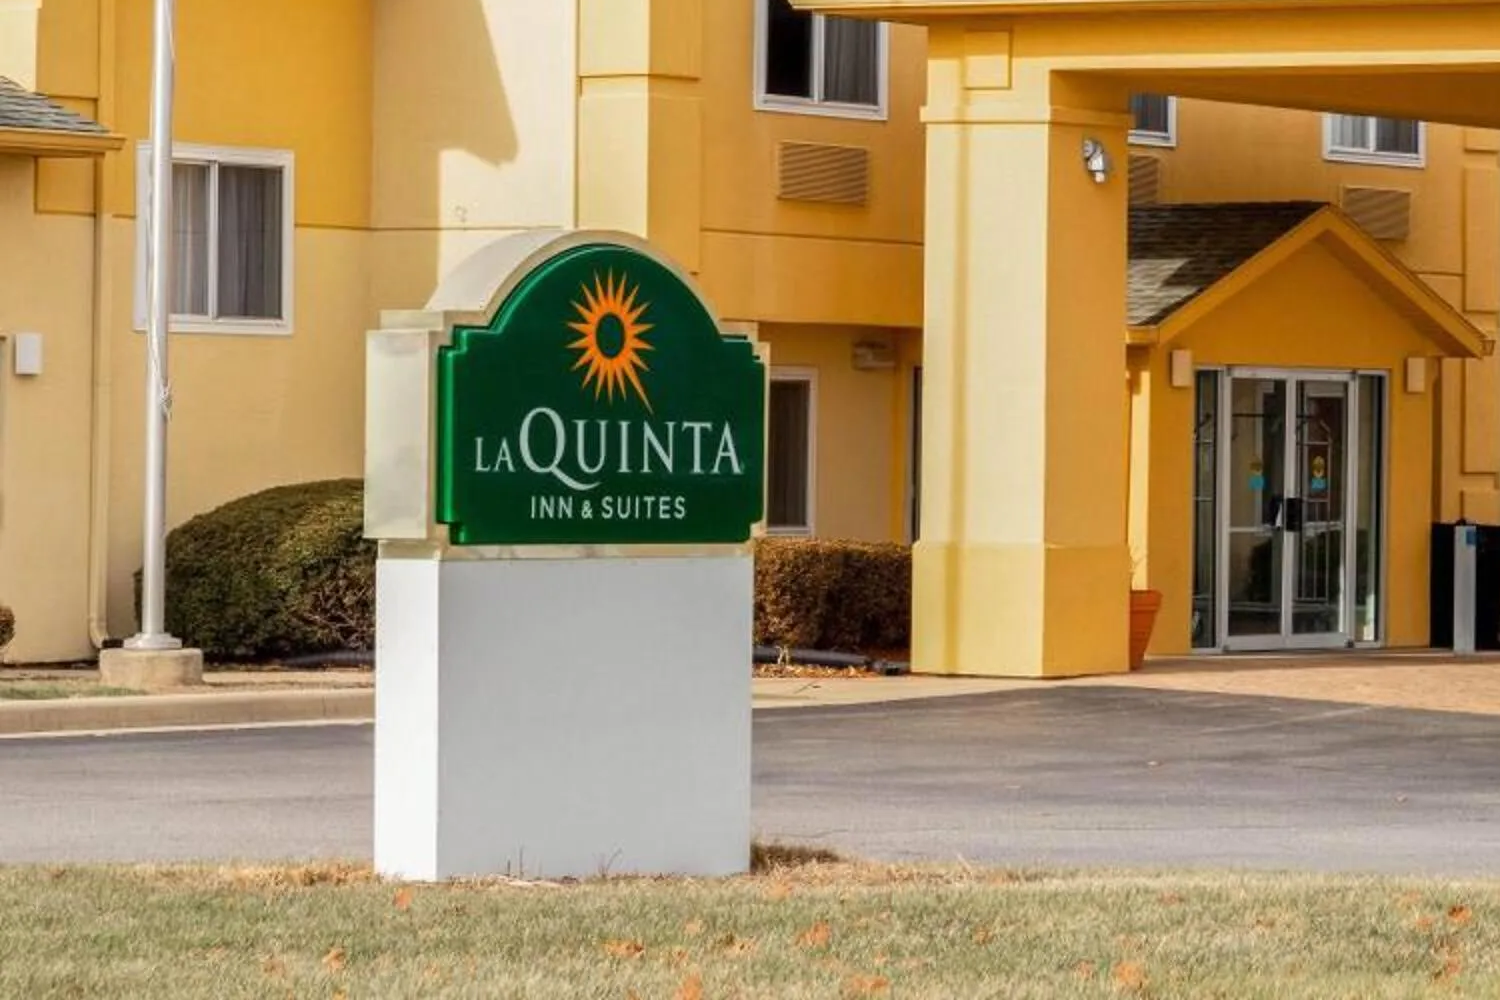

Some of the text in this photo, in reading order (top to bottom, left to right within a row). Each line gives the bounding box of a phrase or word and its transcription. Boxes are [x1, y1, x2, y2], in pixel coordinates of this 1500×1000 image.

[475, 406, 743, 491] LA QUINTA
[530, 495, 686, 520] INN & SUITES
